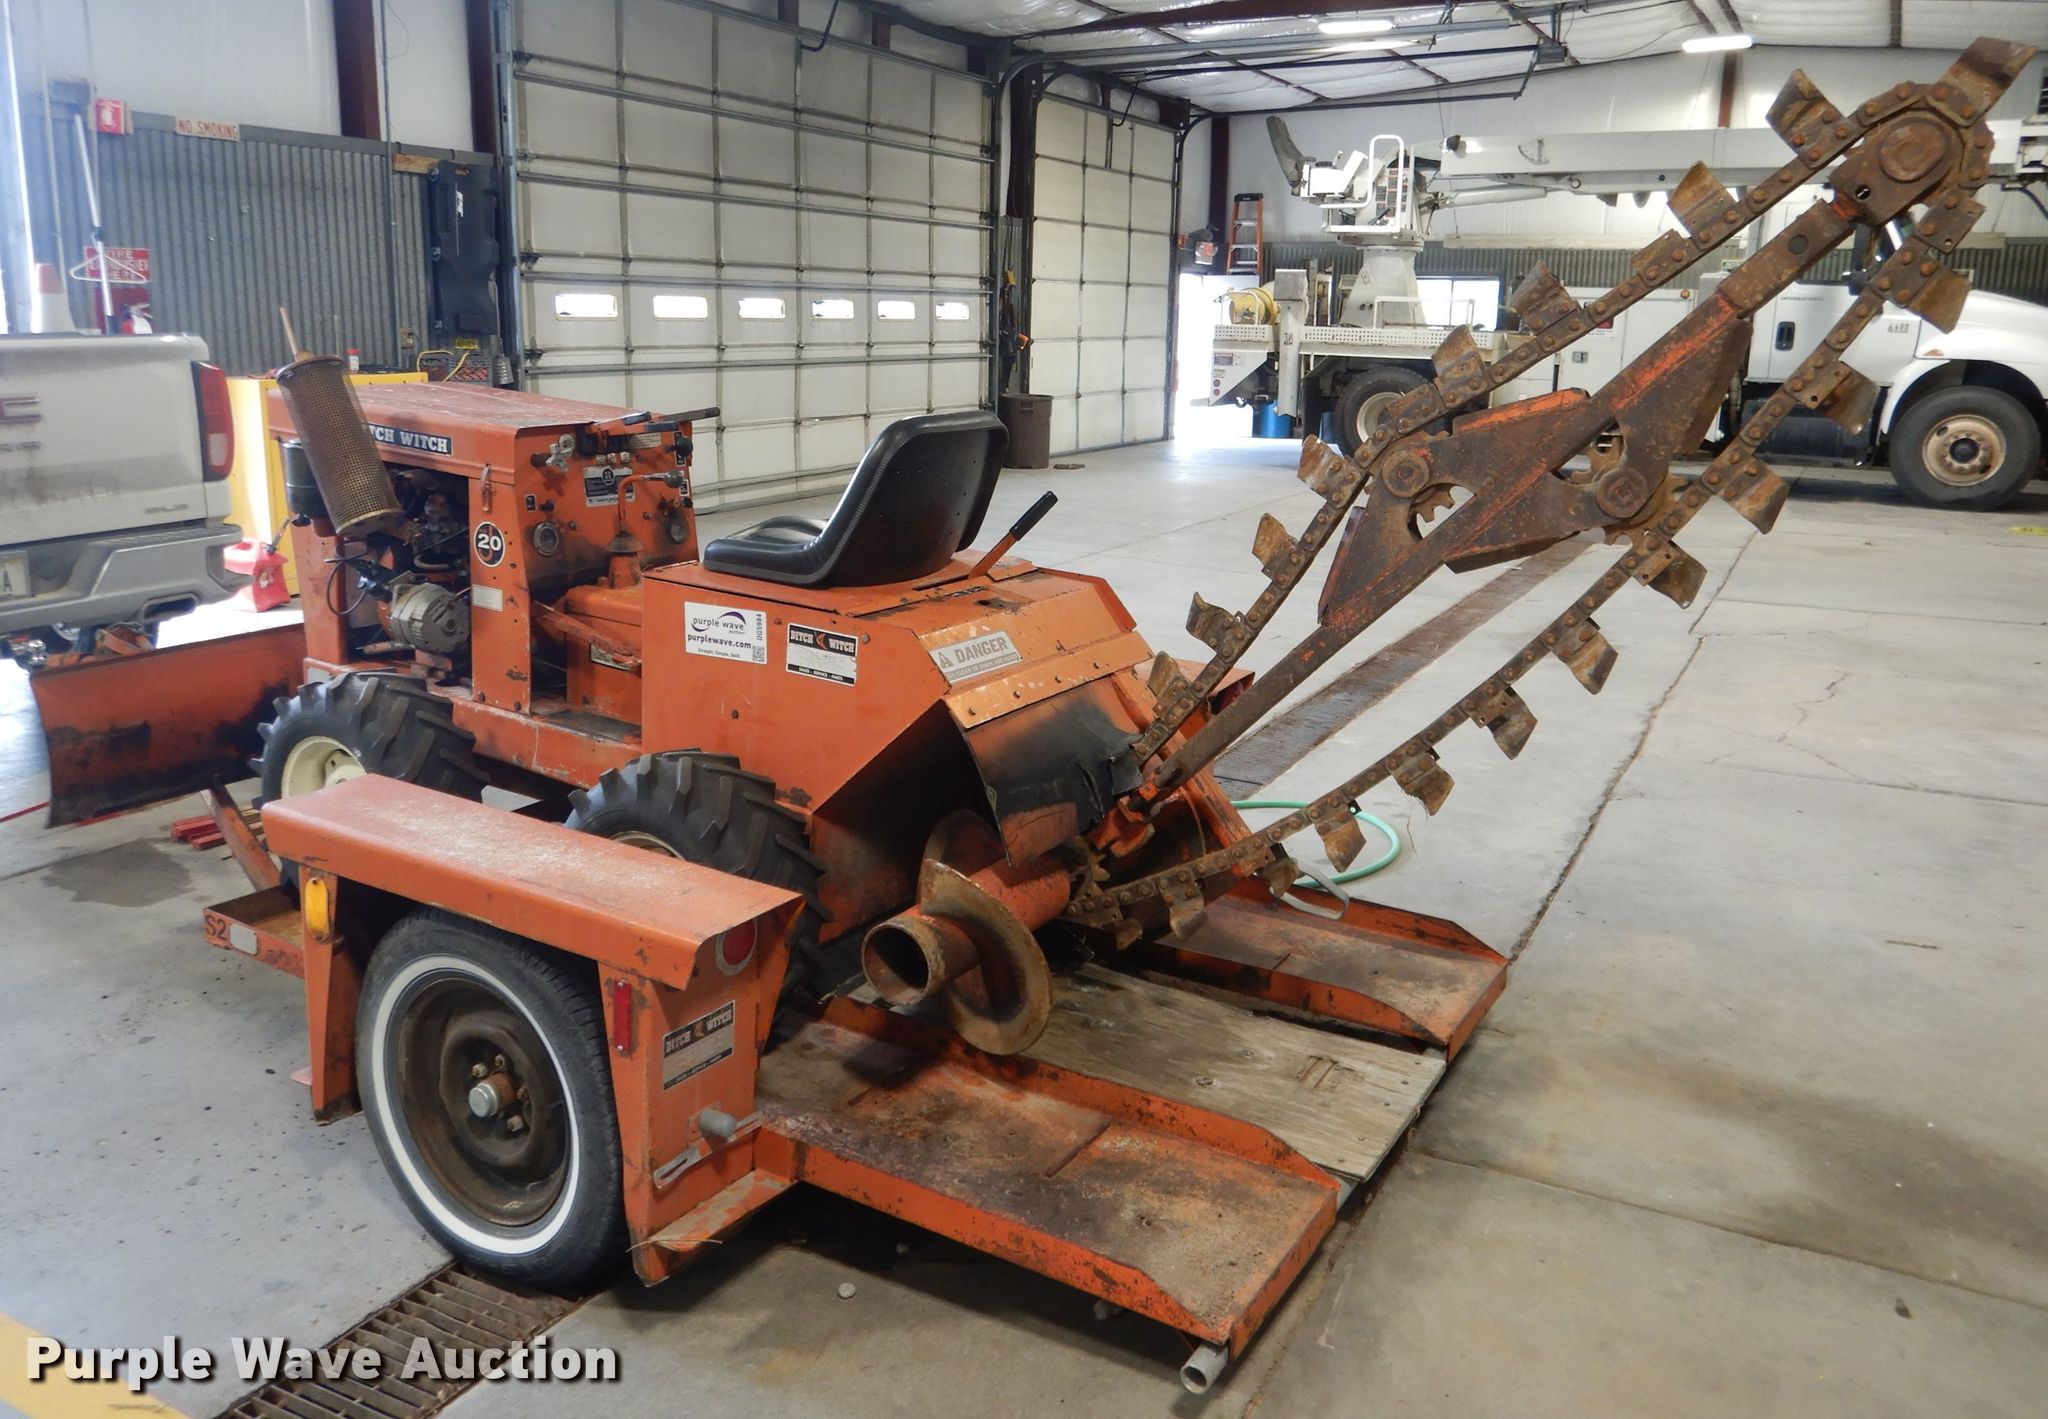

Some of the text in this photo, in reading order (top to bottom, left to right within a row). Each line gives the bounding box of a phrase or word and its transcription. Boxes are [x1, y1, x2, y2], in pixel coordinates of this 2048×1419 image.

[178, 120, 237, 139] NO SMOKING
[400, 431, 448, 453] WITCH
[478, 533, 502, 552] 20
[692, 617, 745, 636] purple wave
[687, 634, 752, 649] purplewave.com
[790, 630, 855, 653] DITCH WITCH
[954, 637, 1009, 662] DANGER
